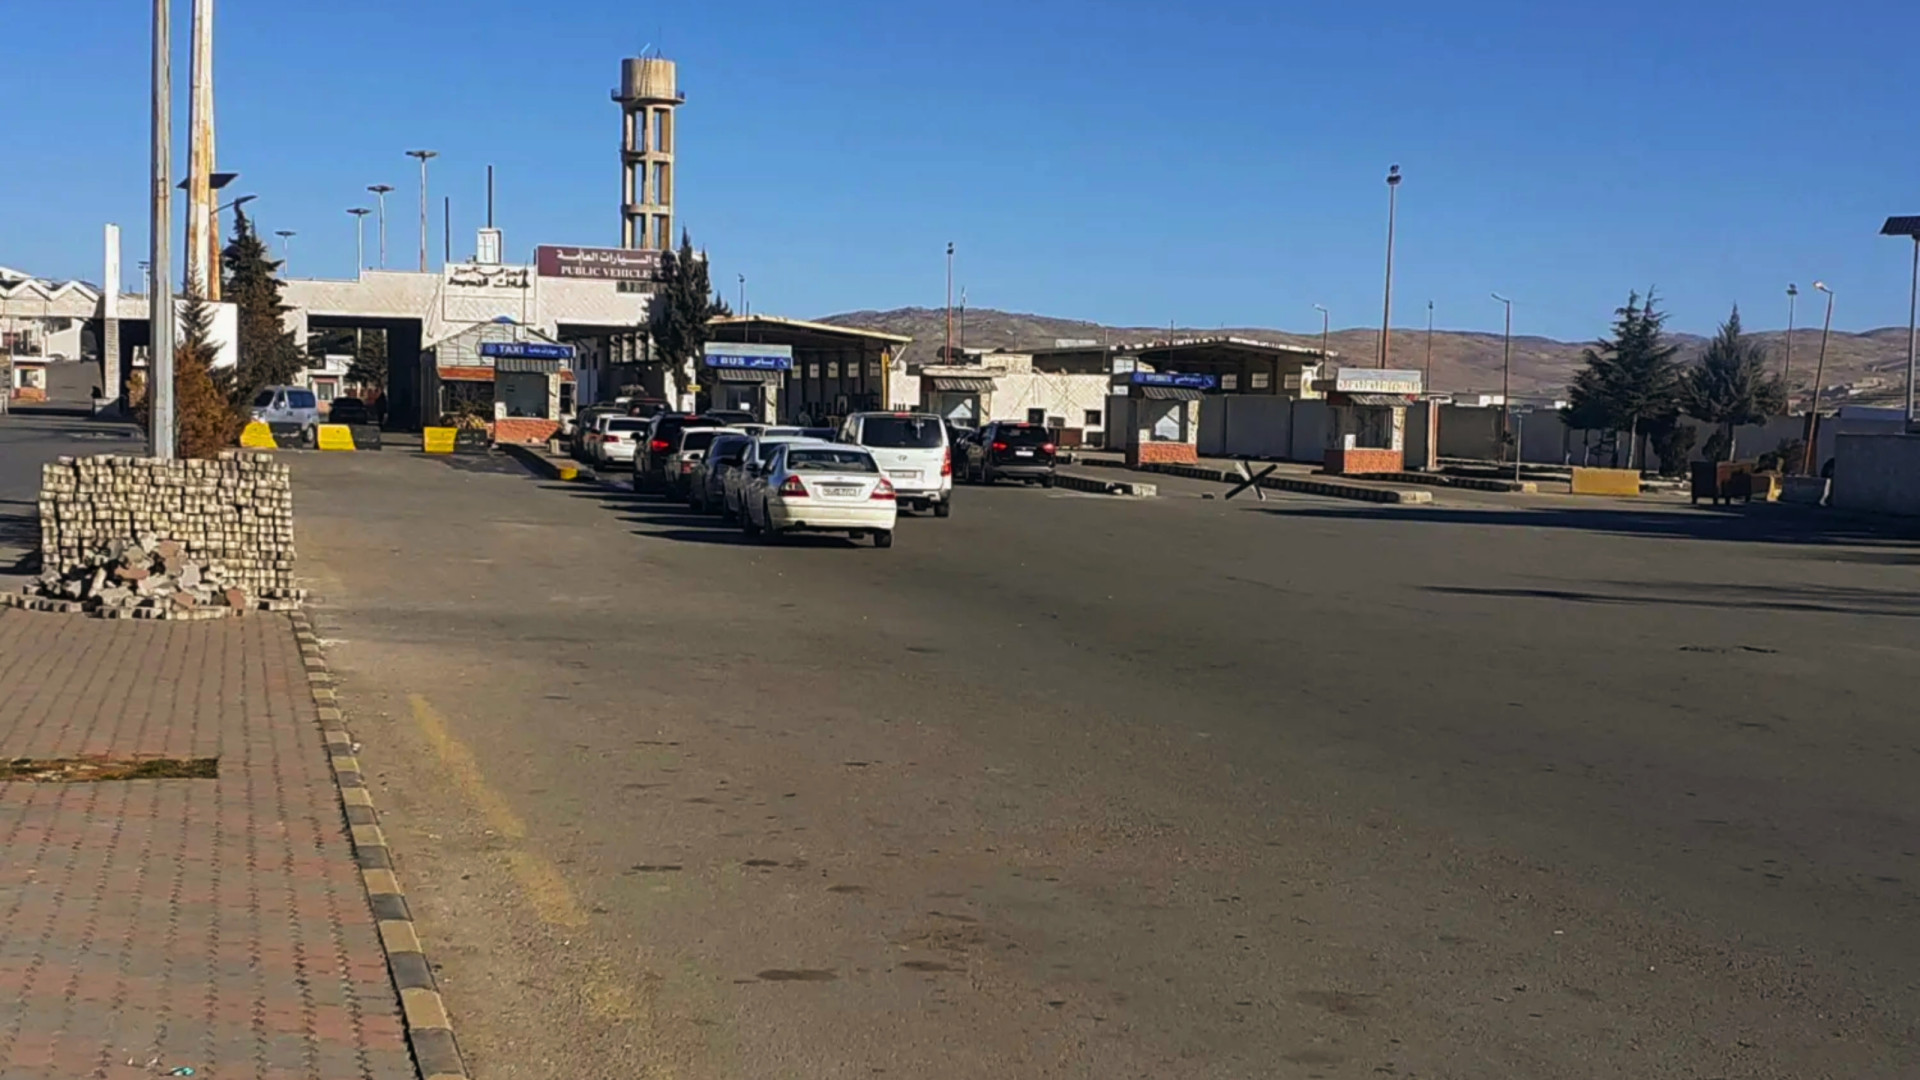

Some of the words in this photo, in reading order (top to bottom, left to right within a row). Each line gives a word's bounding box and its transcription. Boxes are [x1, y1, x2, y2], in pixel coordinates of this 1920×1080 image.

[556, 248, 598, 262] العامة
[600, 251, 652, 267] السيارات
[561, 265, 600, 276] PUBLIC
[602, 267, 653, 279] VEHICLE
[499, 345, 524, 354] TAXI
[720, 356, 745, 365] BUS
